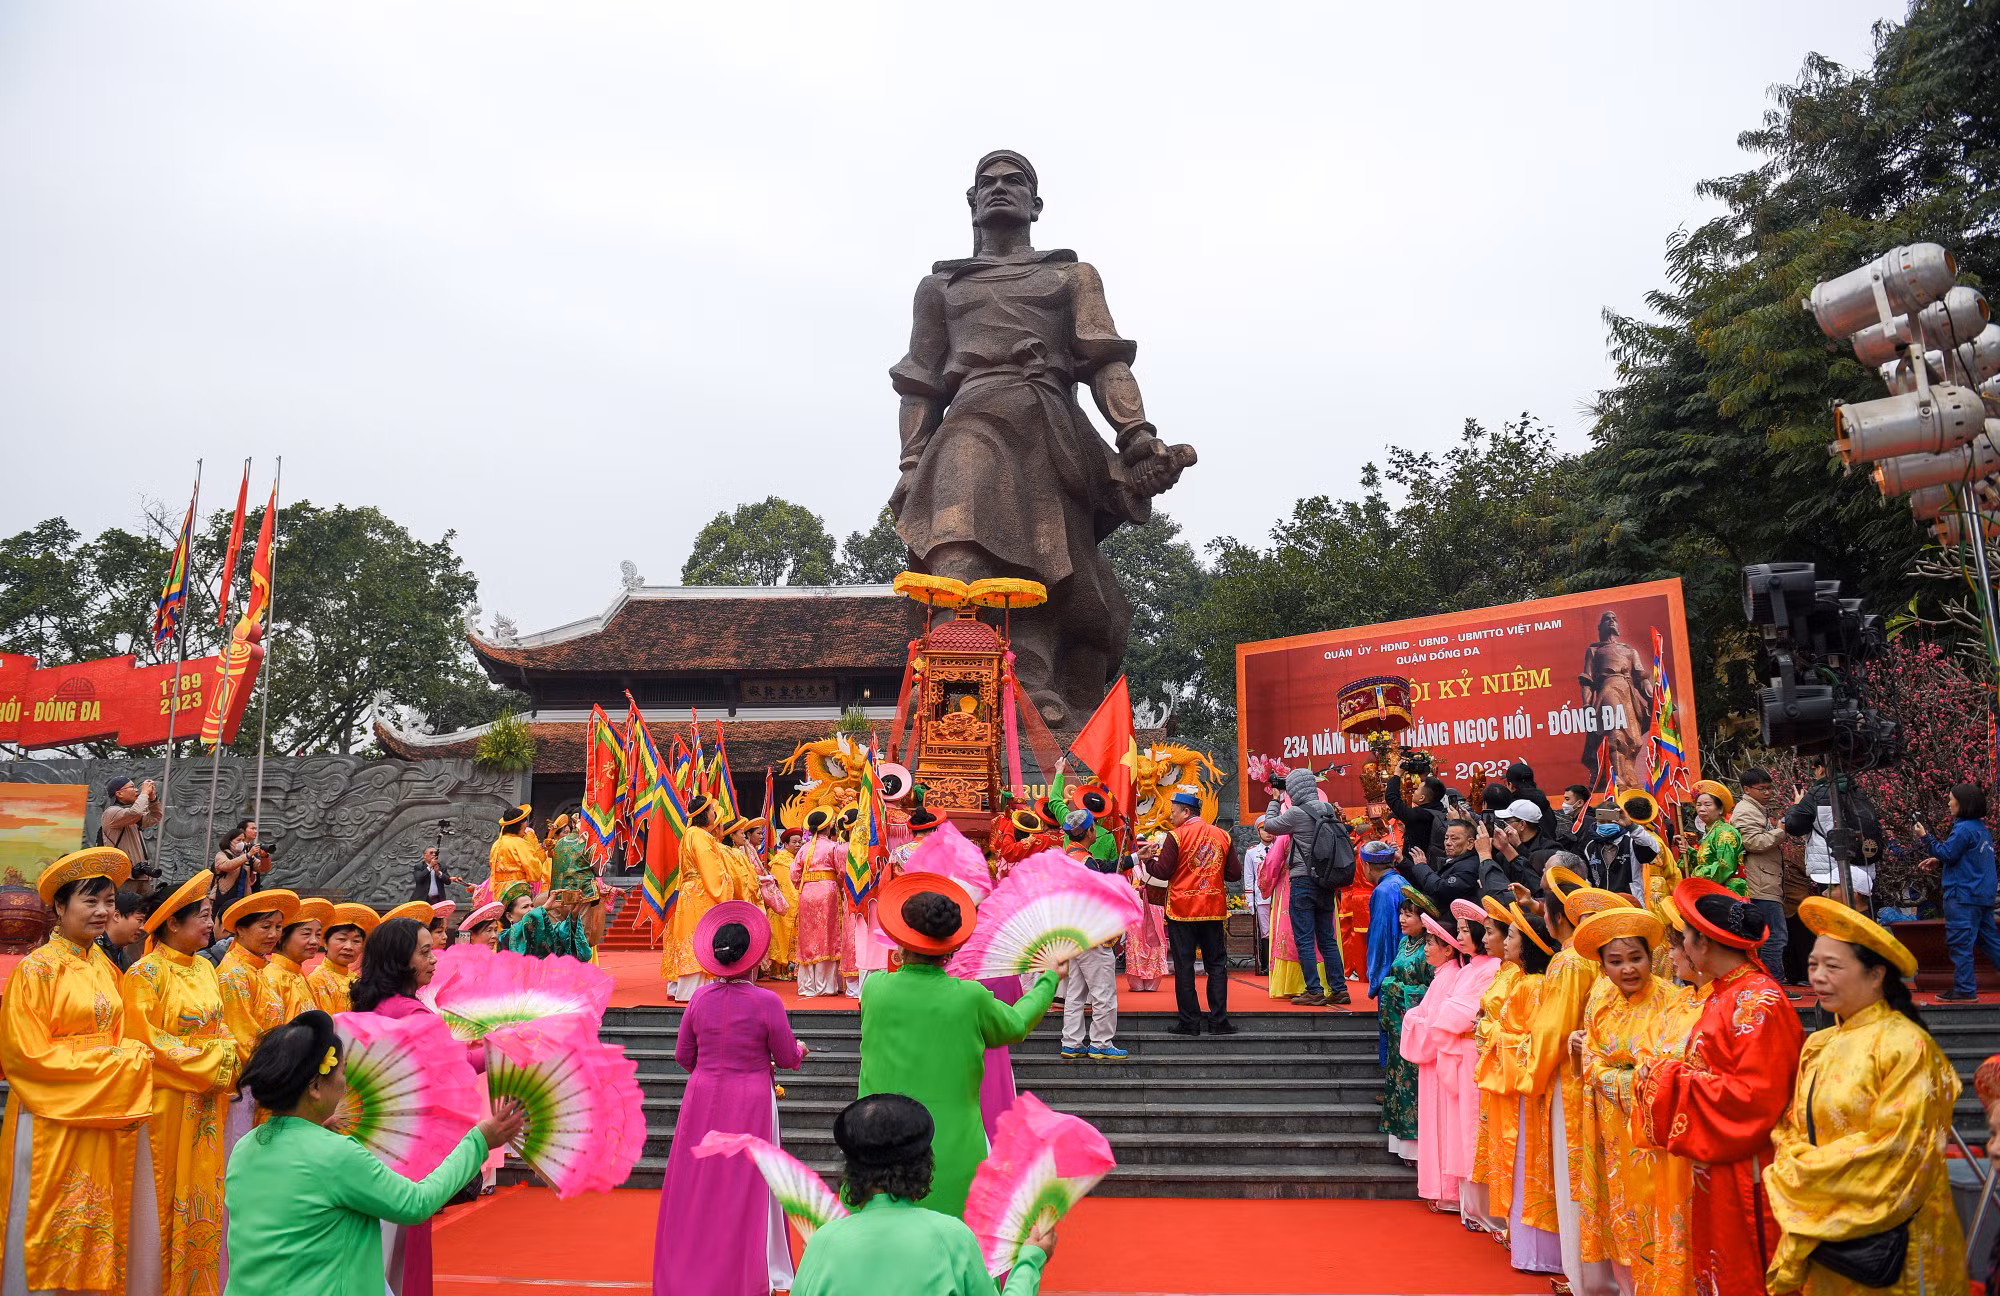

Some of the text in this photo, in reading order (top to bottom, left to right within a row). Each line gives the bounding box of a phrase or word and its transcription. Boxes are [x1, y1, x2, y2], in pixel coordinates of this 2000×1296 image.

[1324, 648, 1353, 660] QUẬN
[1358, 644, 1372, 656] ỦY
[1380, 641, 1410, 653] HĐND
[1418, 636, 1449, 648] UBND
[1458, 628, 1504, 643] UBMTTQ
[1506, 623, 1531, 636] VIỆT
[1534, 619, 1562, 632] NAM
[1396, 647, 1480, 666] QUẬN ĐỐNG ĐA
[159, 672, 202, 697] 1789
[1409, 664, 1553, 708] ỘI KỶ NIỆM
[33, 694, 77, 722] ĐỐNG
[80, 700, 101, 722] ĐA
[159, 691, 202, 716] 2023
[1283, 735, 1309, 759] 234
[1312, 728, 1346, 756] NĂM
[1453, 716, 1499, 748] NGỌC
[1502, 705, 1532, 740] HỒI
[1547, 700, 1598, 736] ĐỐNG
[1601, 703, 1629, 731] ĐA
[1455, 758, 1512, 781] 2023
